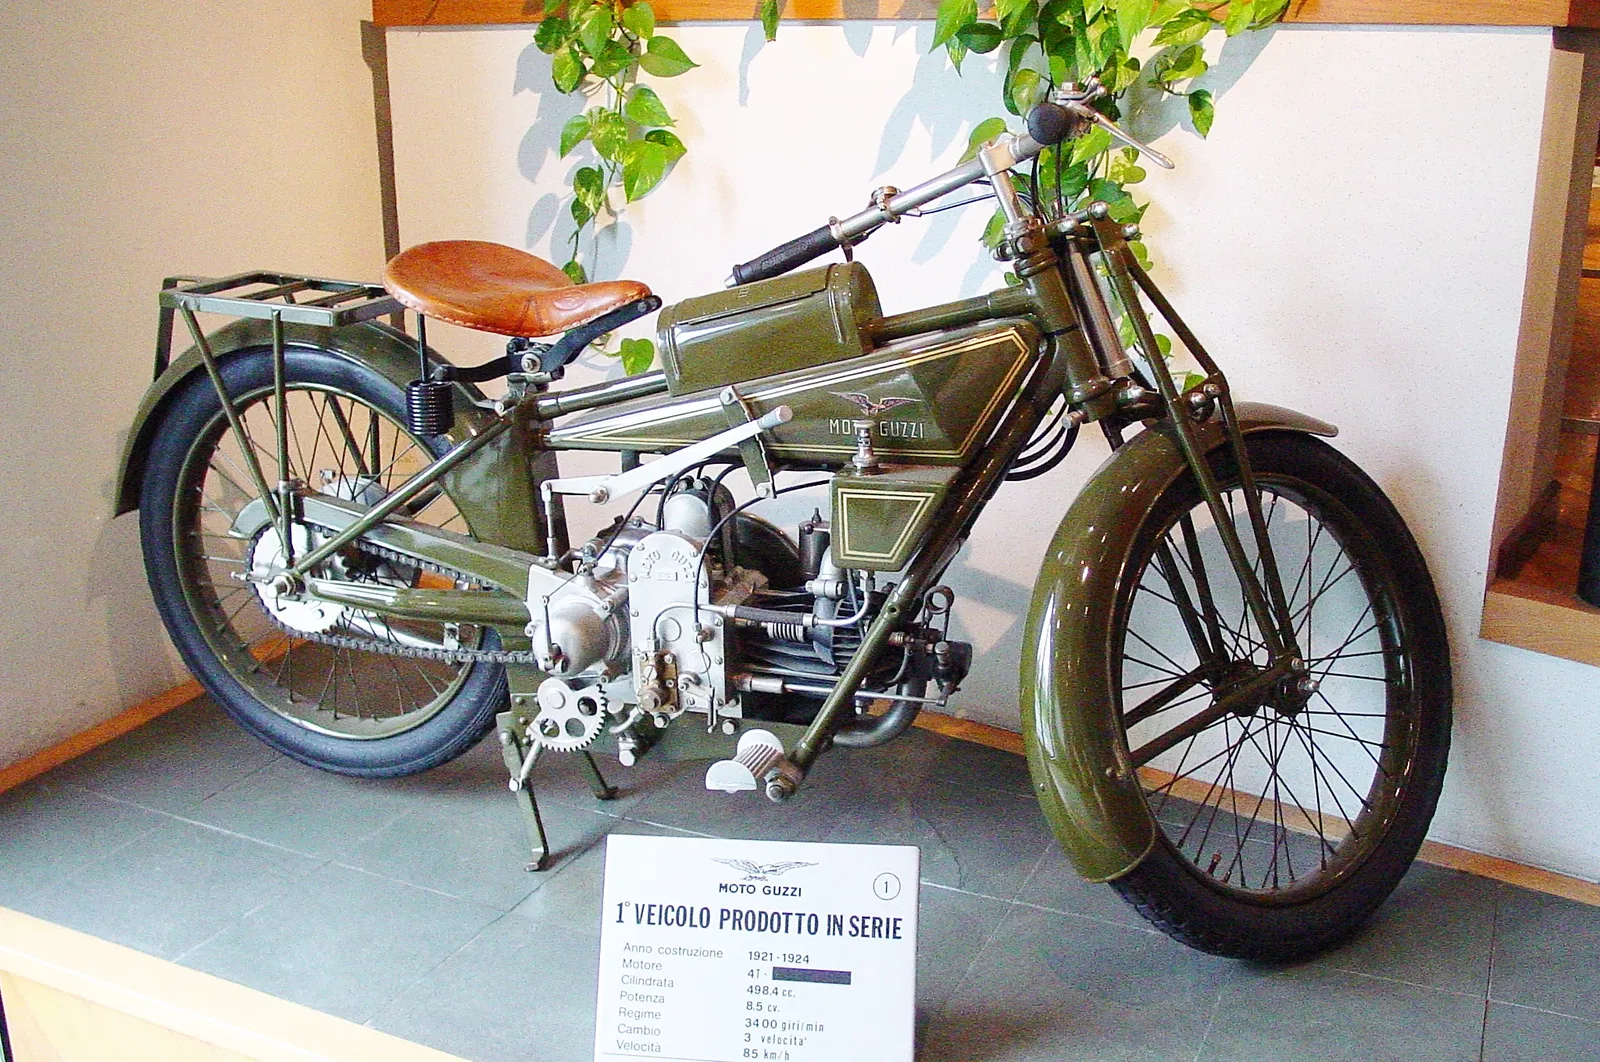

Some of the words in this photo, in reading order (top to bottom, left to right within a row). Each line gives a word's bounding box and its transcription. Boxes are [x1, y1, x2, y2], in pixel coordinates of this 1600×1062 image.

[829, 418, 870, 434] MOT
[879, 421, 924, 439] GUZZI
[719, 883, 756, 894] MOTO
[762, 885, 802, 897] GUZZI
[635, 903, 711, 929] VEICOLO
[719, 908, 819, 936] PRODOTTO
[826, 914, 844, 937] IN
[849, 915, 902, 940] SERIE
[623, 942, 652, 954] Anno
[658, 946, 723, 958] costruzione
[622, 958, 662, 970] Motore
[621, 974, 674, 988] Cilindrata
[620, 990, 665, 1003] Potenza
[747, 984, 779, 996] 498.4
[782, 988, 796, 998] cc.
[618, 1007, 661, 1020] Regime
[746, 1001, 763, 1011] 8.5
[767, 1004, 780, 1012] cv.
[617, 1023, 661, 1036] Cambio
[745, 1018, 778, 1029] 3400
[781, 1020, 824, 1032] giri/min
[744, 1033, 751, 1042] 3
[616, 1039, 661, 1053] Velocità
[743, 1048, 759, 1059] 85
[763, 1049, 790, 1061] km/h
